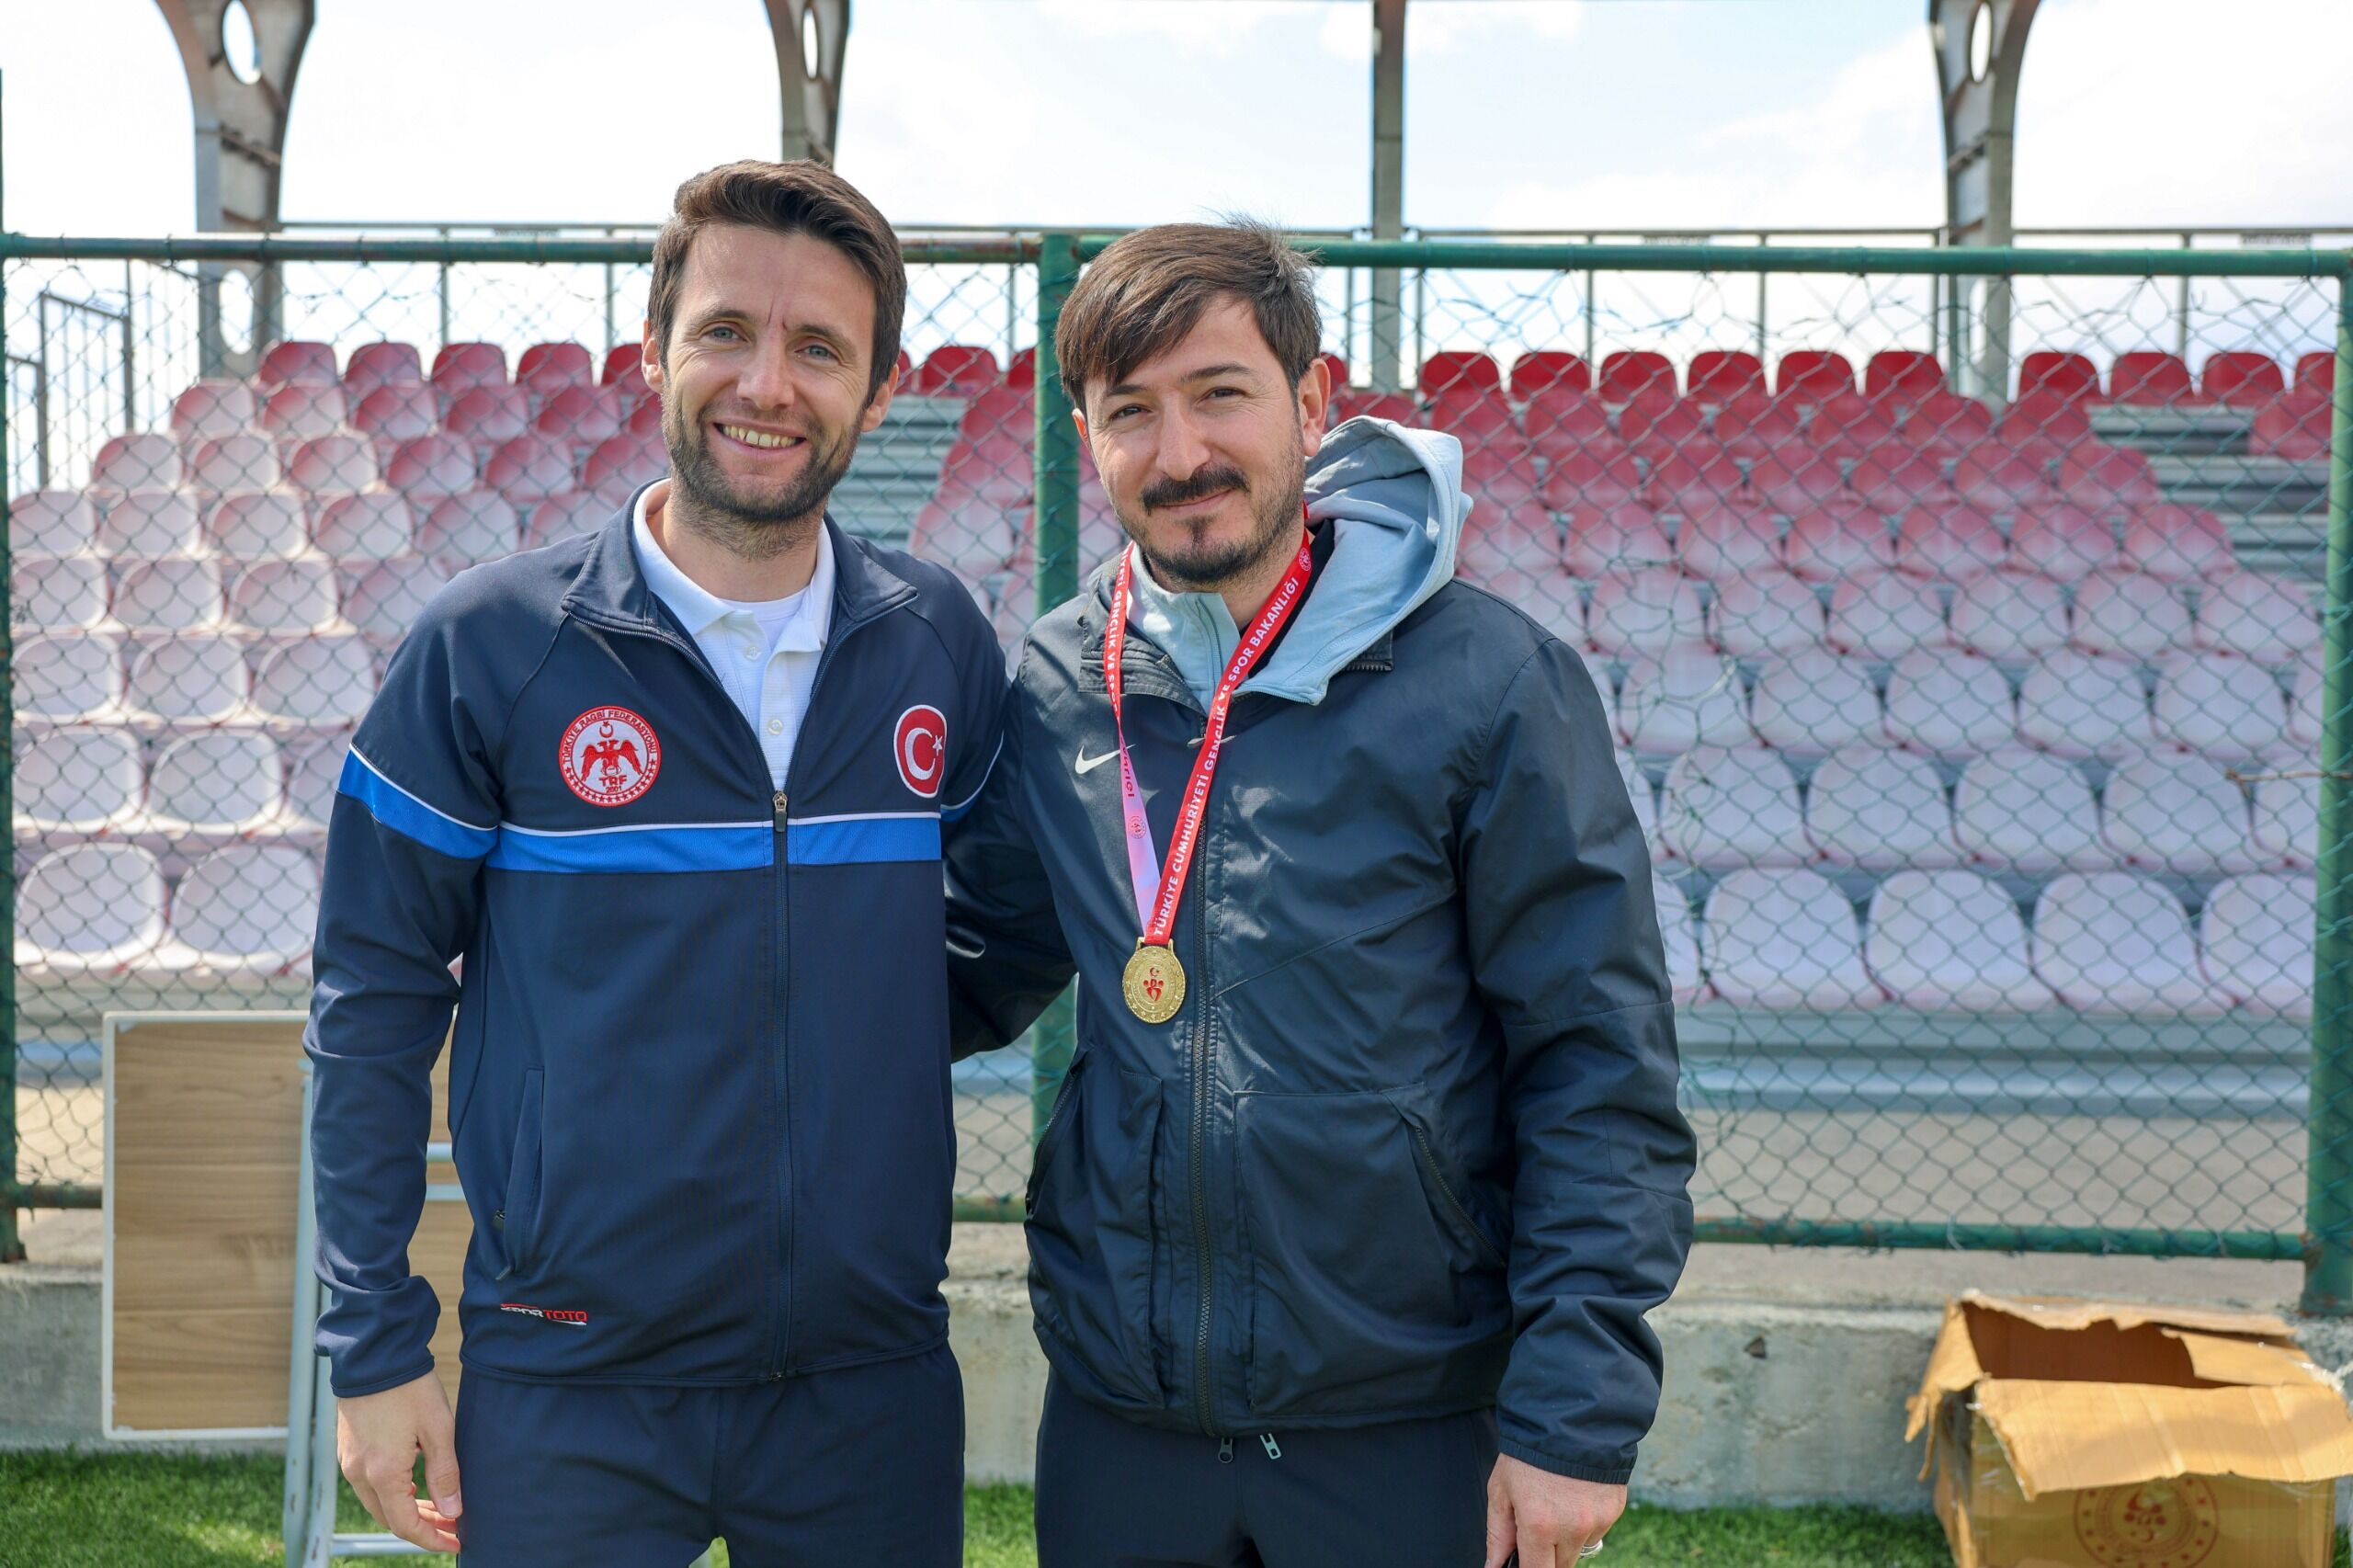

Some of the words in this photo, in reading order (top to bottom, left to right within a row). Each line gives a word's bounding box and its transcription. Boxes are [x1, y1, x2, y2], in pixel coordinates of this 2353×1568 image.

[1108, 590, 1121, 649] GENÇLİK
[1108, 653, 1116, 670] VE
[580, 710, 606, 728] RAGBİ
[608, 710, 657, 754] FEDERASYONU
[1154, 875, 1179, 937] TÜRKİYE
[1171, 773, 1210, 873] CUMHURİYETİ
[1204, 705, 1225, 771] GENÇLİK
[1217, 684, 1231, 700] VE
[1227, 647, 1256, 682] SPOR
[1248, 576, 1300, 647] BAKANLIĞI
[598, 775, 627, 787] TRF
[542, 1309, 588, 1322] TOTO
